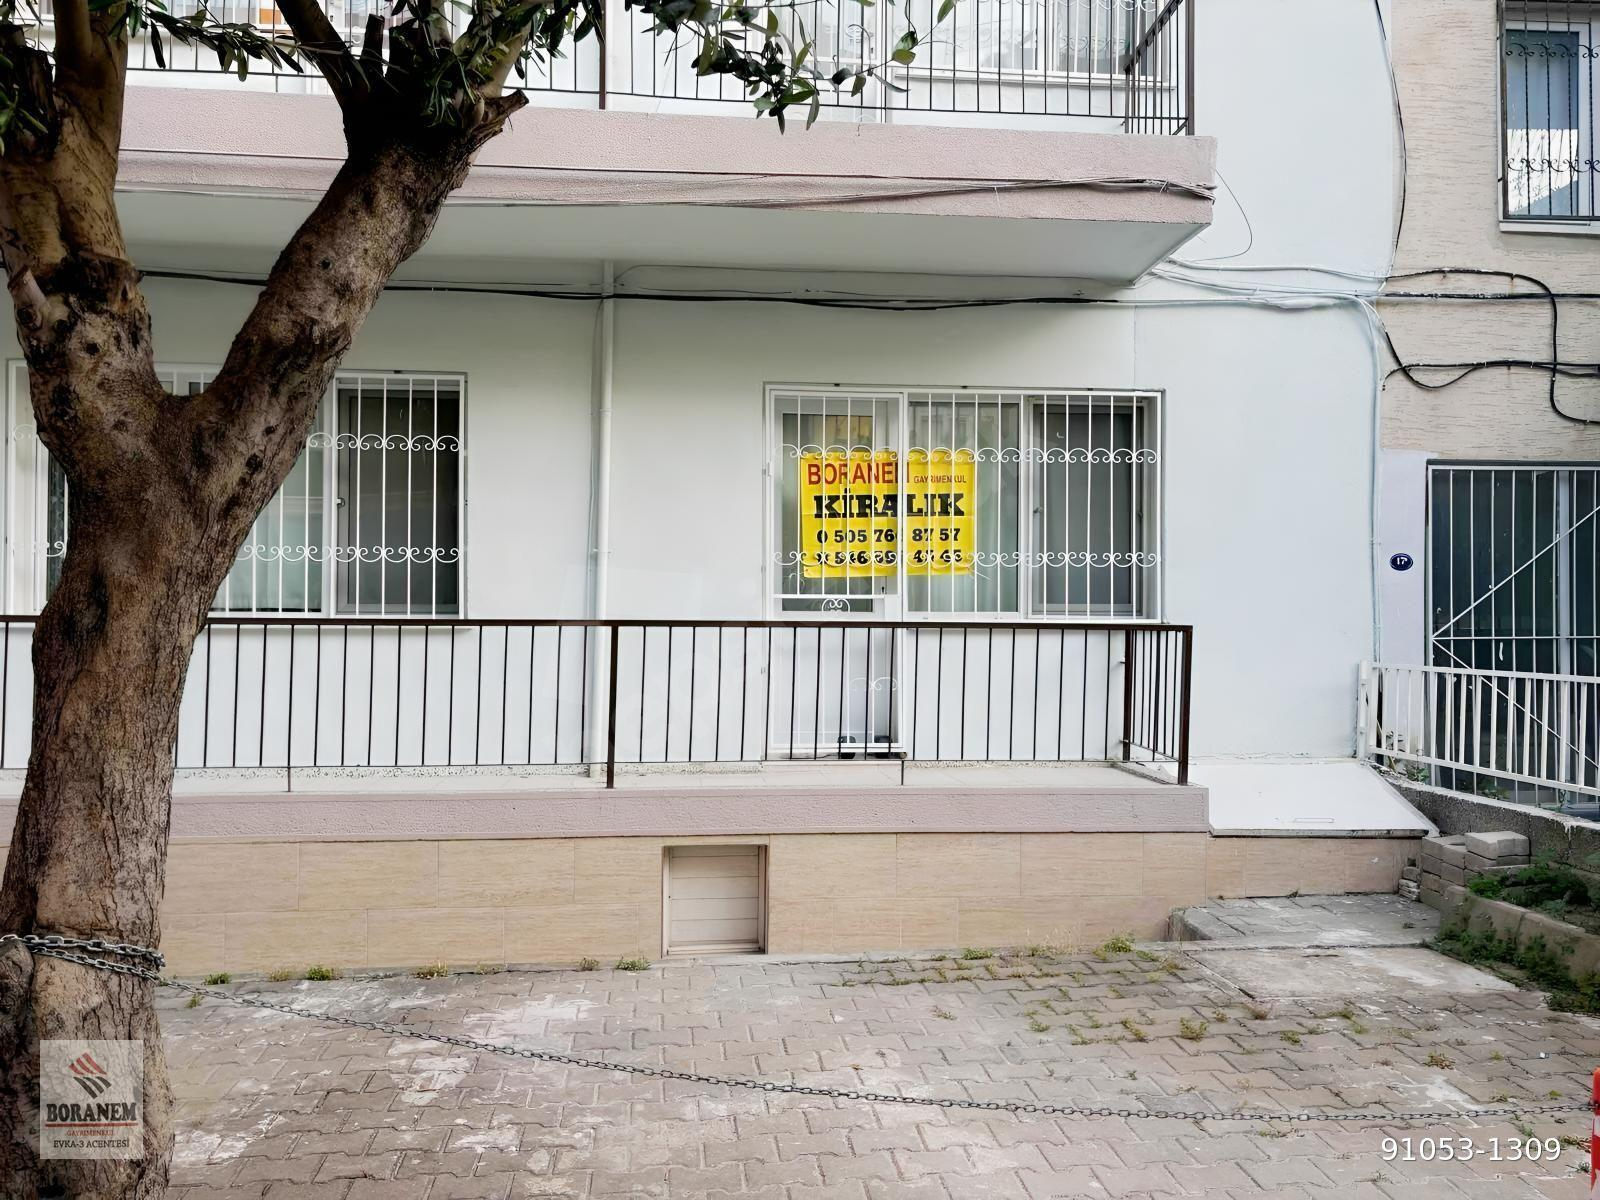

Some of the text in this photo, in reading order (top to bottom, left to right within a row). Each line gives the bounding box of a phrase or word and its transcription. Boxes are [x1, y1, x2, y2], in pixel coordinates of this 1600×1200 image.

[813, 487, 965, 518] KİRALIK
[834, 529, 868, 543] 505
[874, 528, 899, 543] 76
[939, 527, 961, 542] 57
[1396, 556, 1408, 565] 17
